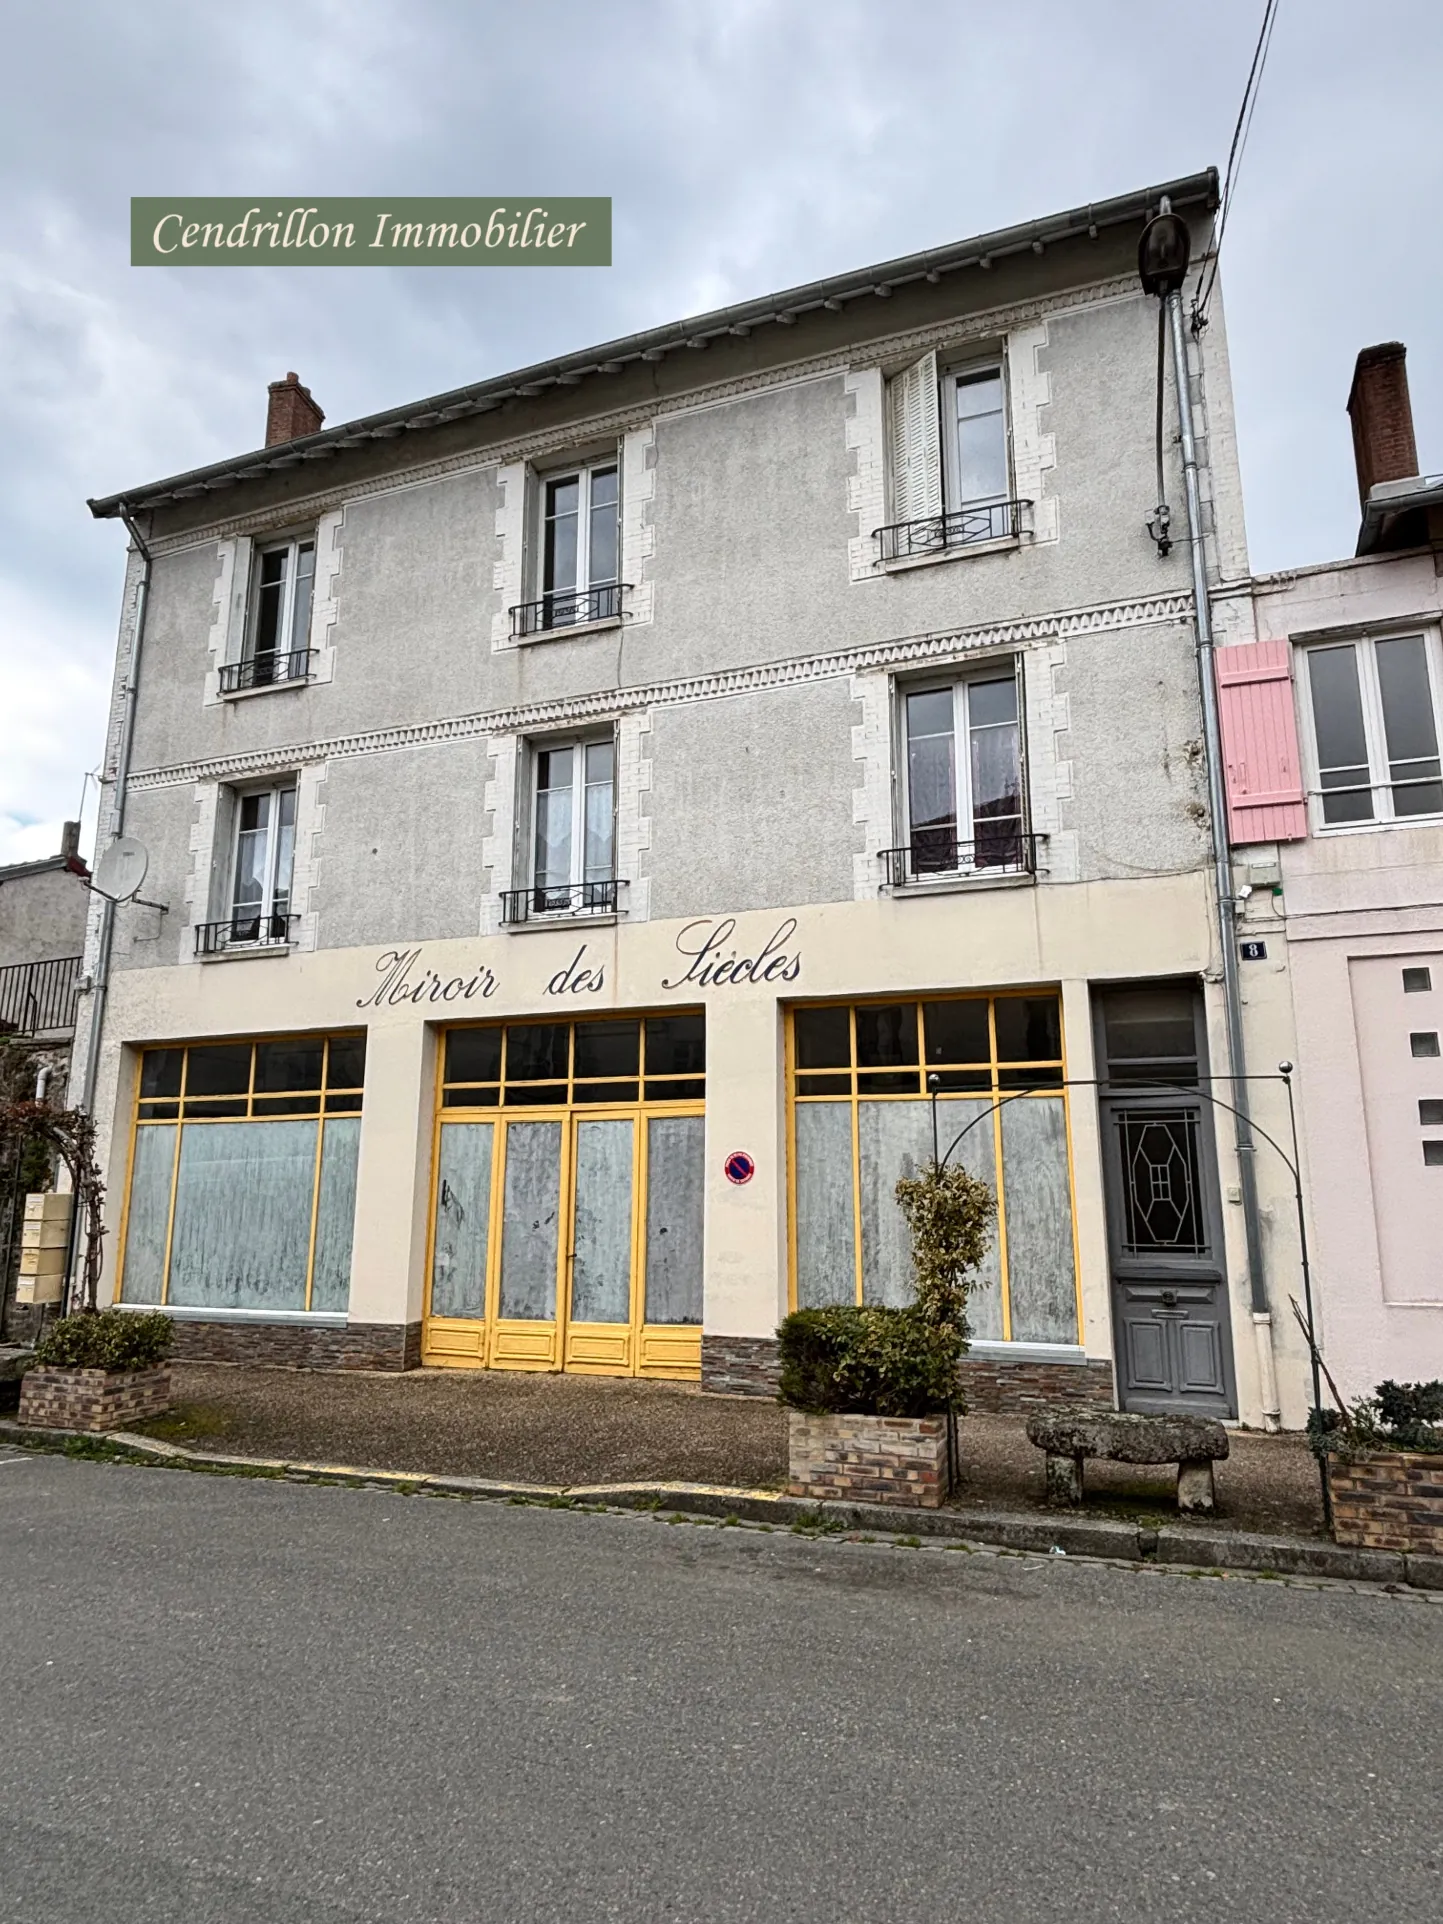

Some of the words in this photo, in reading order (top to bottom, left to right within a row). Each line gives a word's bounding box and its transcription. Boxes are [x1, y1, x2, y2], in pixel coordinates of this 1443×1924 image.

[1248, 943, 1259, 957] 8
[356, 948, 500, 1008] Miroir
[543, 944, 605, 996] des
